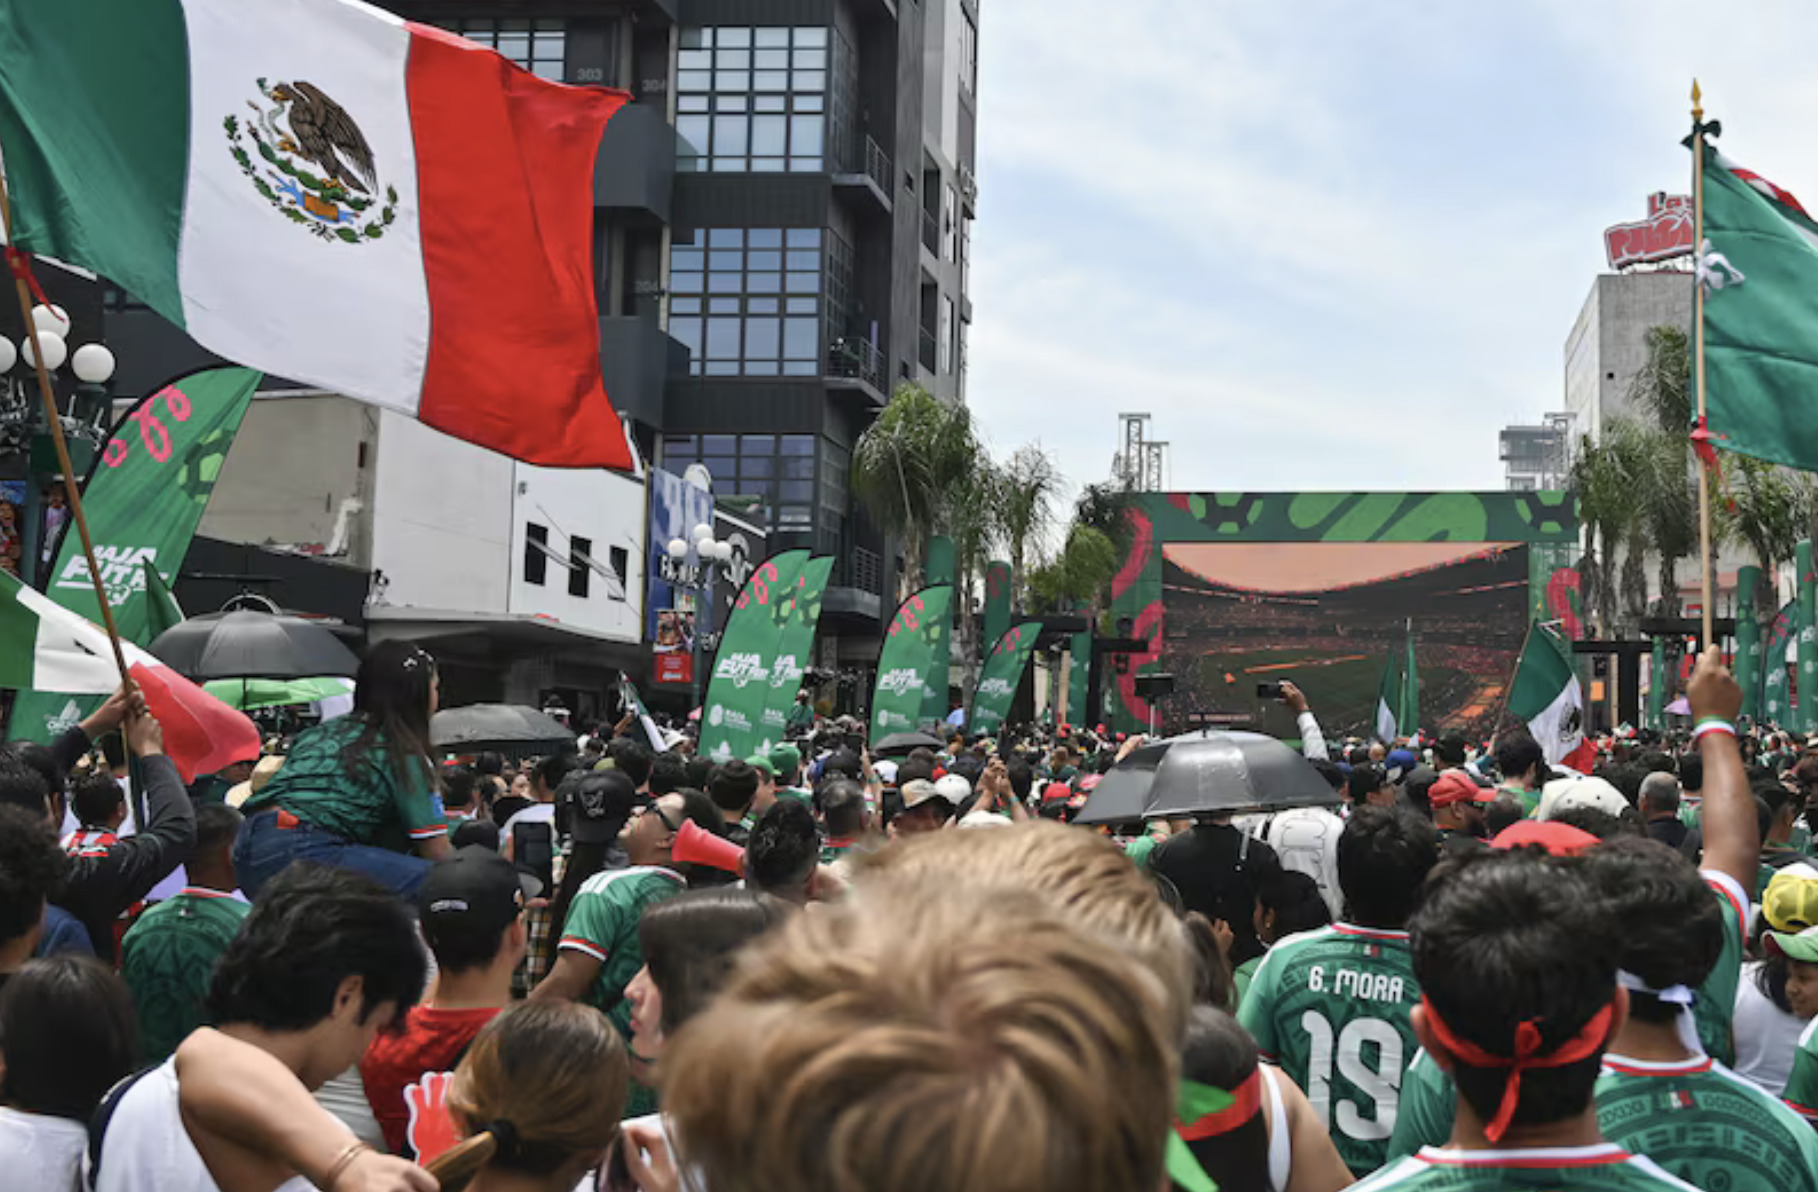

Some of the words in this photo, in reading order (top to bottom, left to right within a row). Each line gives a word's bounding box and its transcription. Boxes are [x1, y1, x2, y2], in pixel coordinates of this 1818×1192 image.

[577, 67, 603, 80] 303
[1335, 969, 1404, 1004] MORA
[1302, 1010, 1404, 1140] 19
